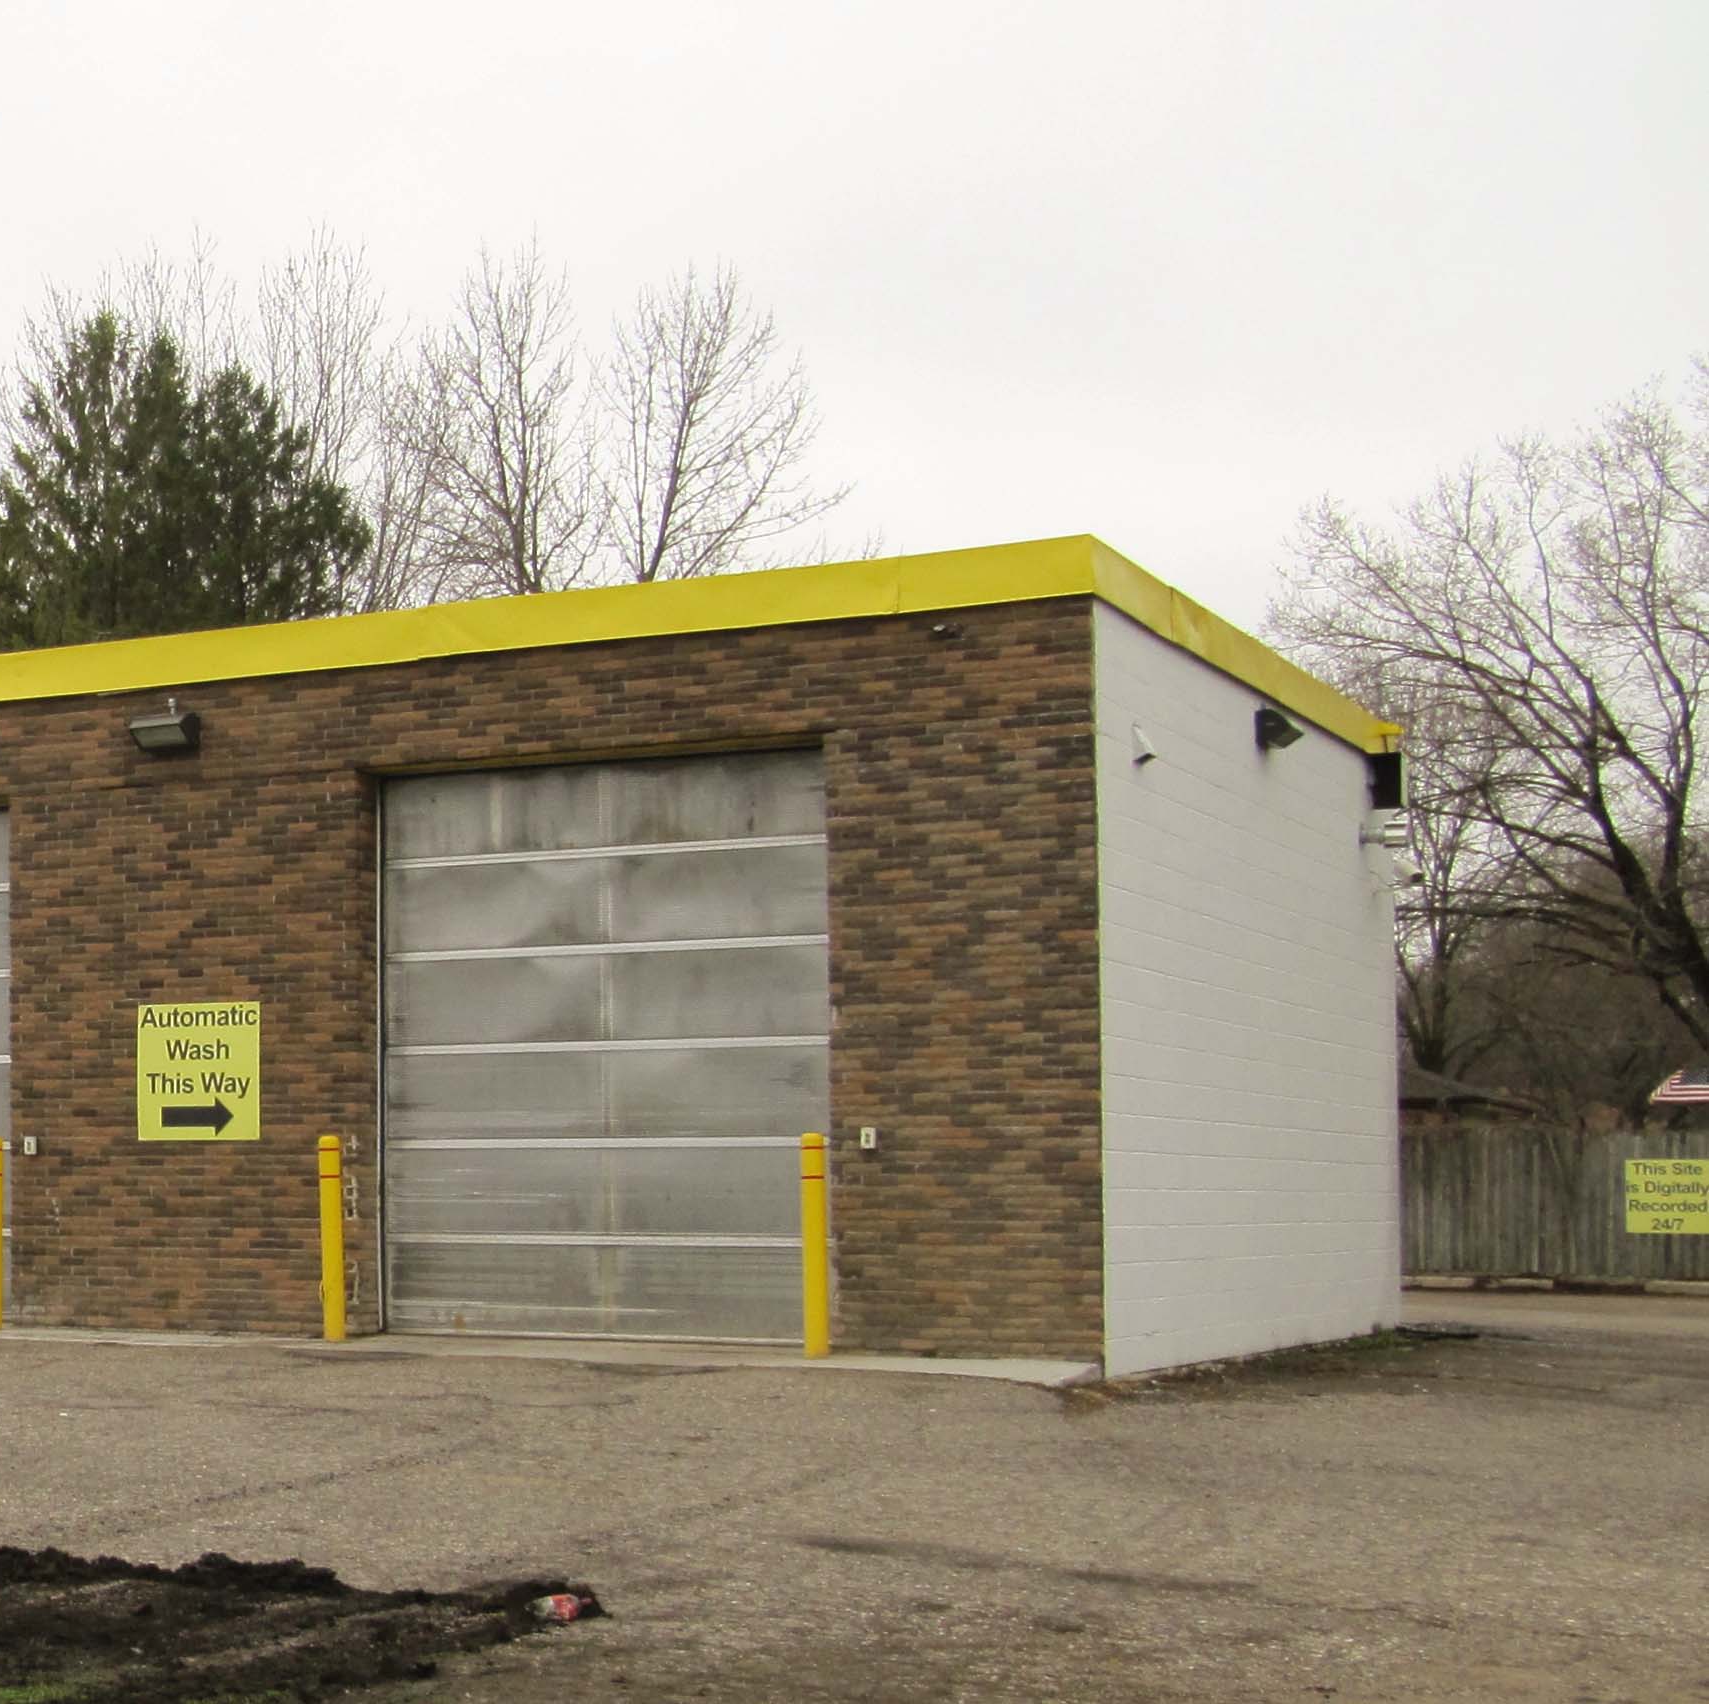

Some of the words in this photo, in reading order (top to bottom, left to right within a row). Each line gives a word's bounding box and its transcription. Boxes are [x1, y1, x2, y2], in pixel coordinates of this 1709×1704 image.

[140, 1004, 258, 1028] Automatic
[166, 1038, 230, 1060] Wash
[146, 1072, 194, 1094] This
[200, 1072, 251, 1099] Way
[1633, 1162, 1667, 1176] This
[1672, 1162, 1703, 1176] Site
[1626, 1182, 1640, 1194] is
[1644, 1180, 1709, 1197] Digitally
[1628, 1199, 1708, 1213] Recorded
[1651, 1218, 1685, 1231] 24/7
